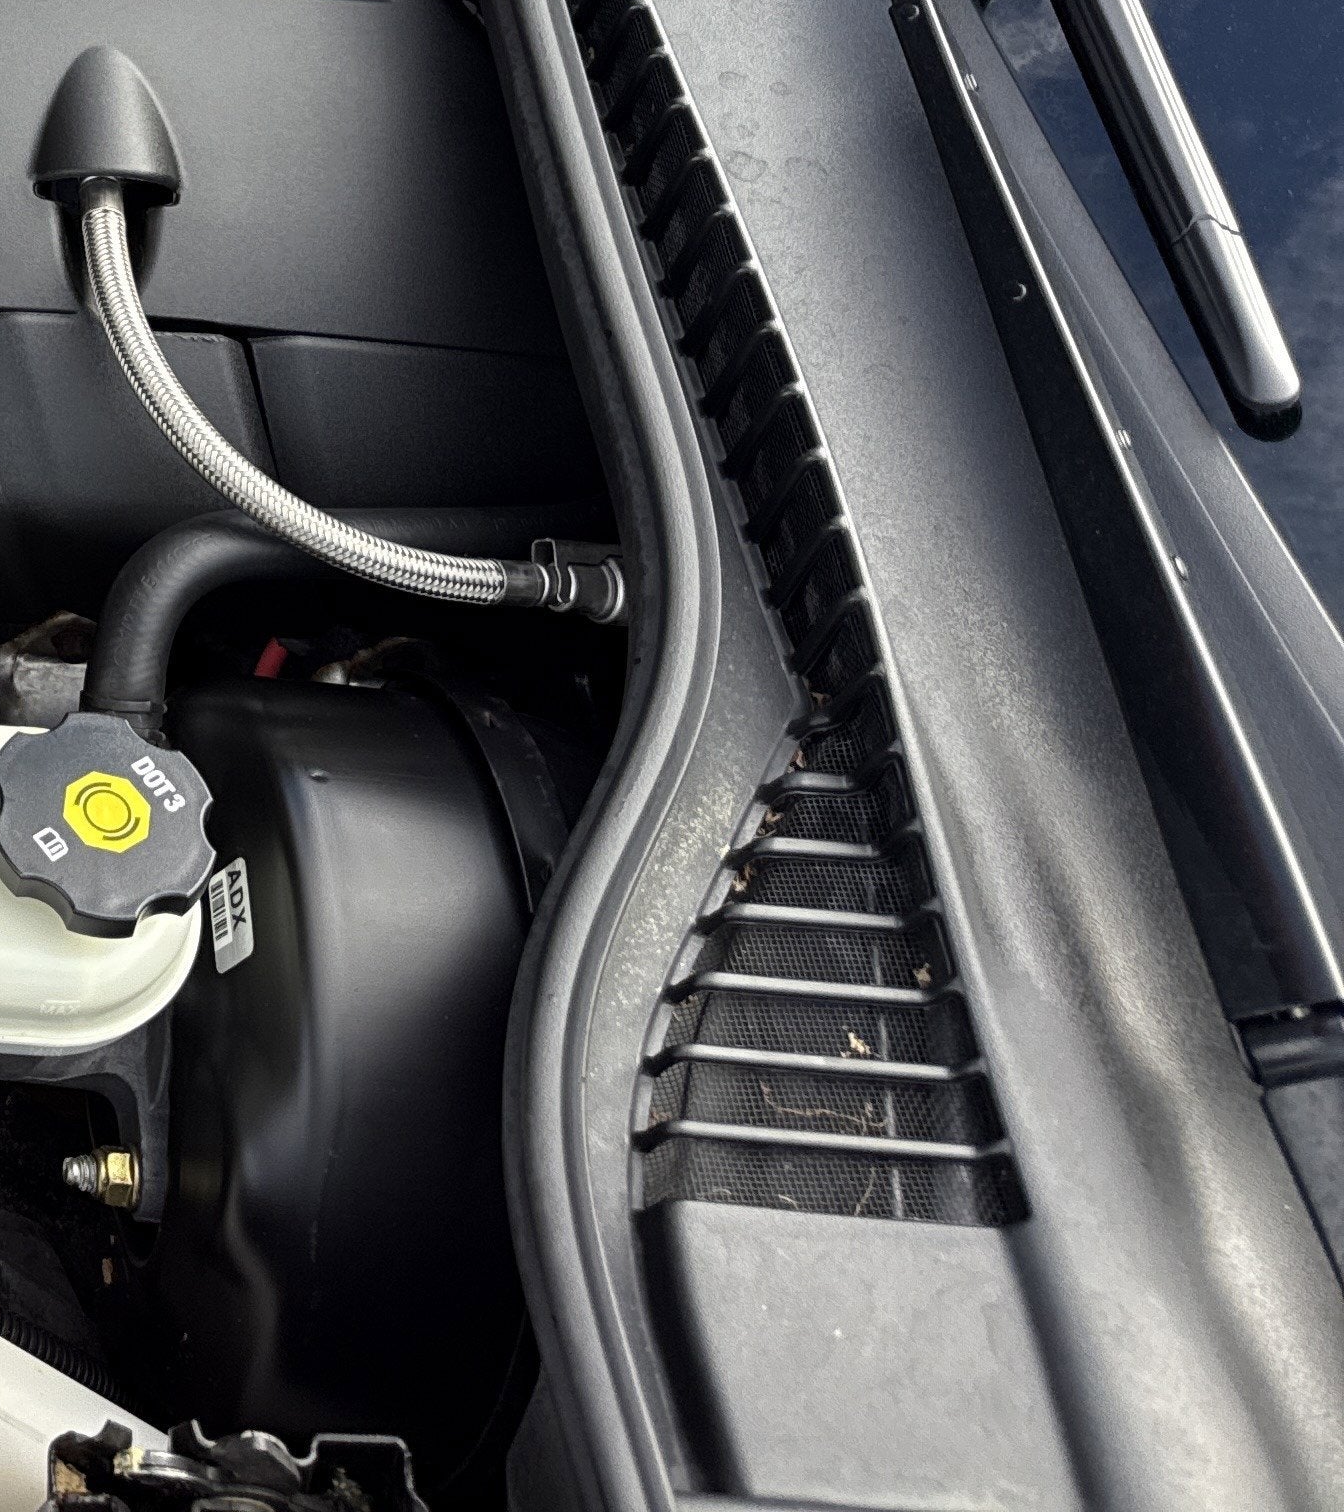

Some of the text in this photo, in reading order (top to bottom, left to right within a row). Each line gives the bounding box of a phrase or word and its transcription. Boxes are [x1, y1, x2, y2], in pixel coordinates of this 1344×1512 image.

[131, 755, 187, 813] DOT 3
[227, 869, 247, 933] ADX
